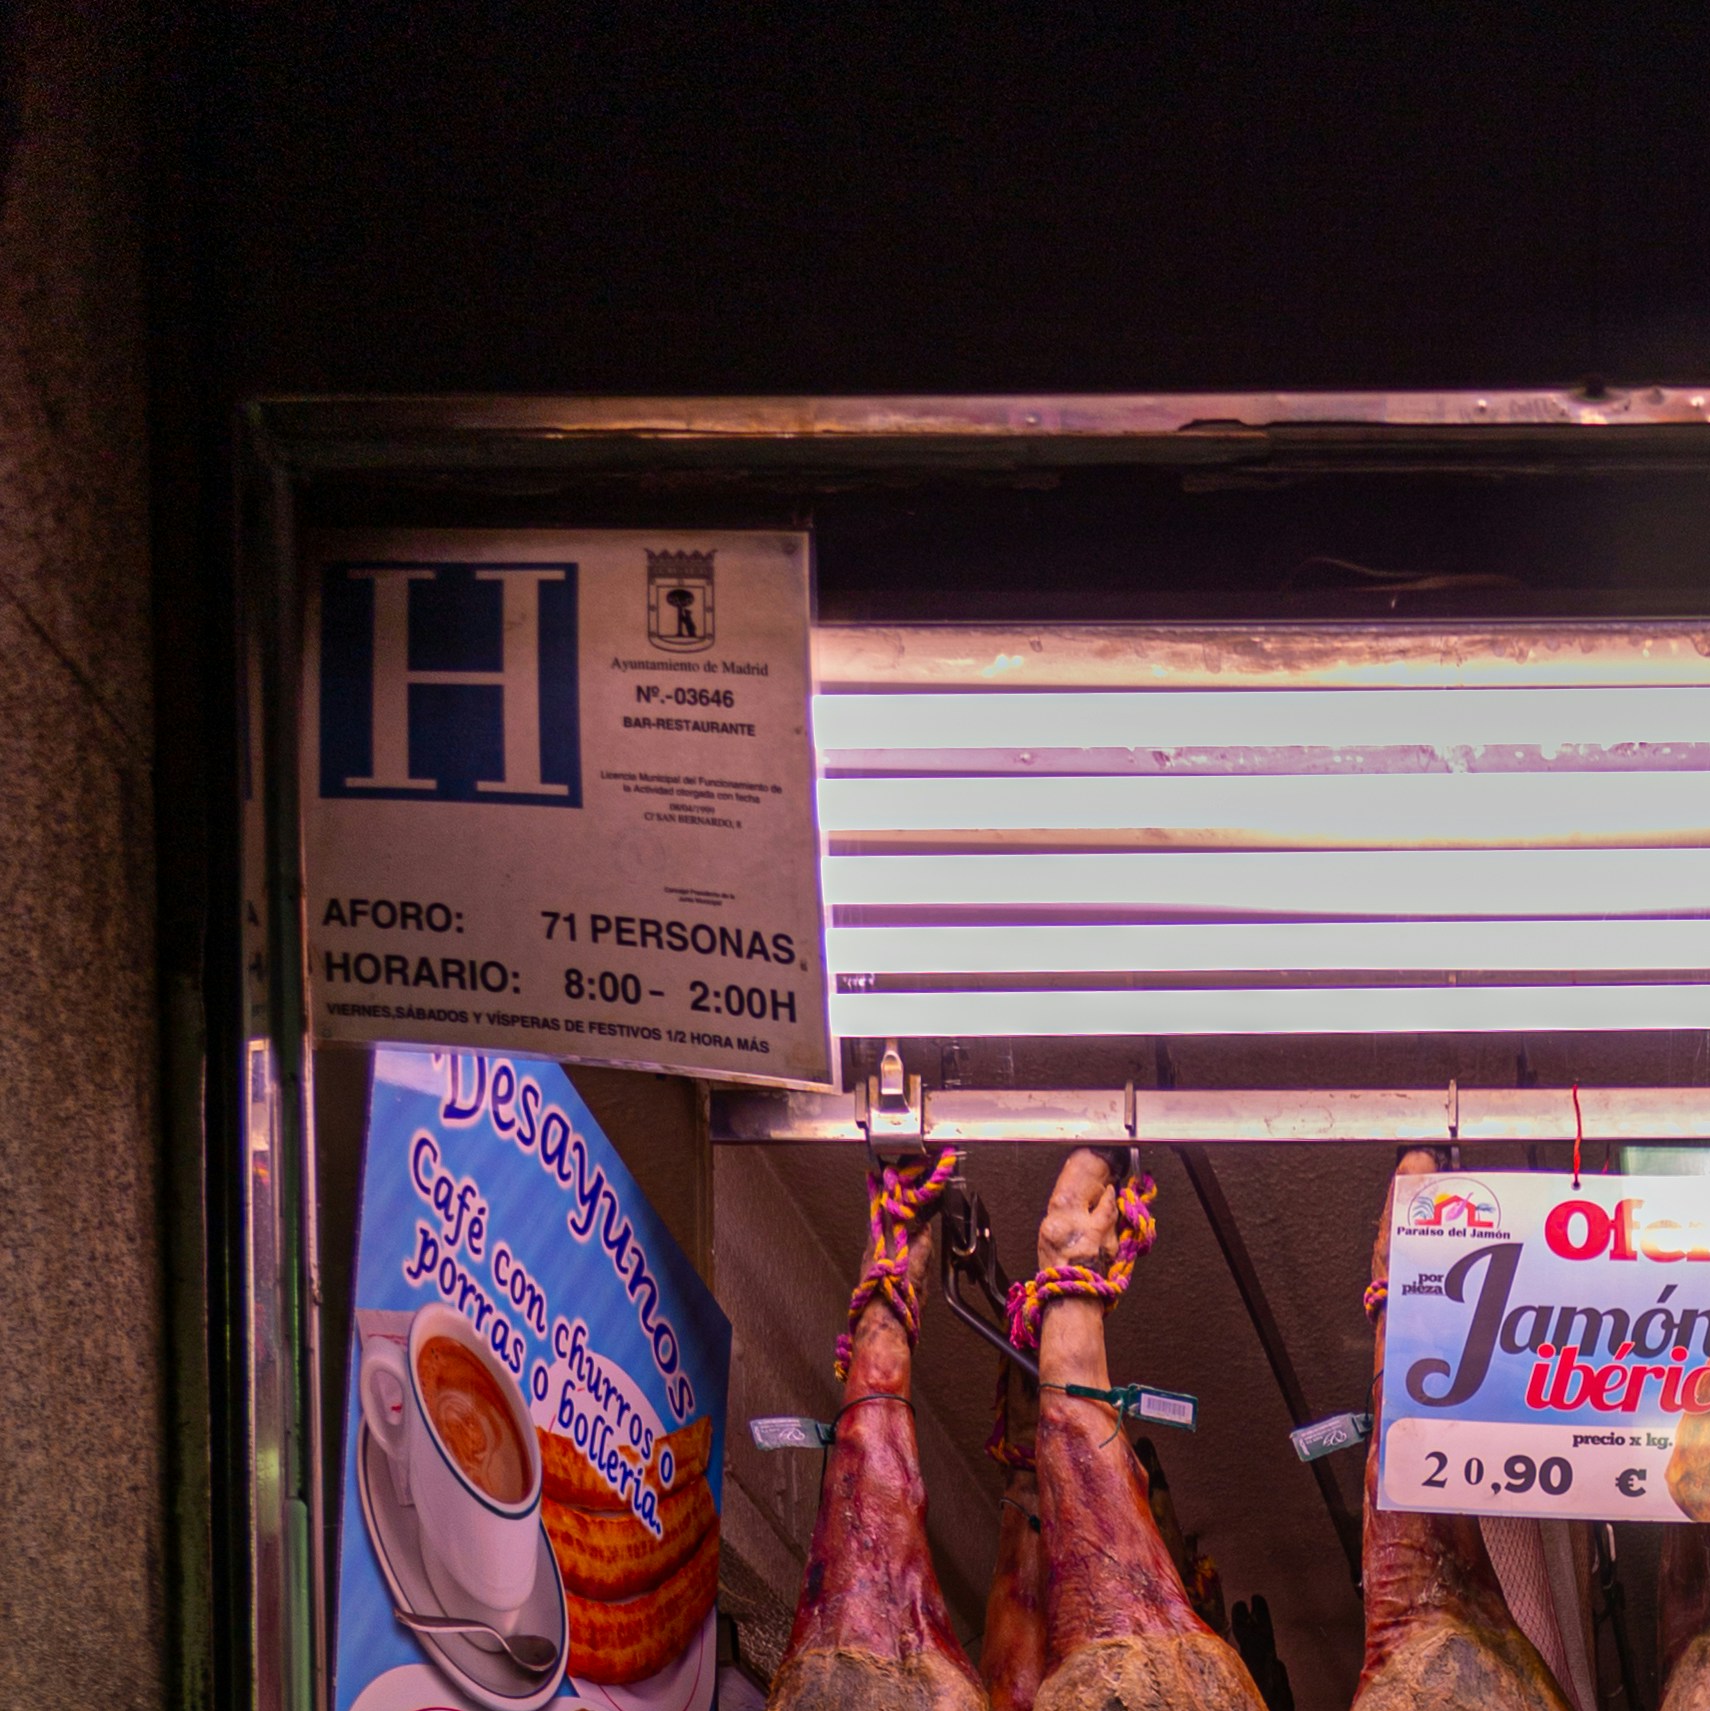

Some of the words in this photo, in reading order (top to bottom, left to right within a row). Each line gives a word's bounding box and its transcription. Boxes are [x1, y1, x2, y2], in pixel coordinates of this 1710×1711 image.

[345, 569, 569, 796] H
[611, 656, 699, 673] Ayuntamiento
[703, 660, 718, 673] de
[722, 661, 769, 678] Madrid
[623, 716, 757, 737] BAR-RESTAURANTE
[322, 898, 464, 934] AFORO:
[541, 911, 577, 942] 71
[590, 914, 797, 966] PERSONAS
[324, 952, 521, 995] HORARIO:
[564, 968, 642, 1004] 8:00
[688, 980, 798, 1023] 2:00H
[474, 1011, 484, 1024] Y
[486, 1009, 561, 1033] VÍSPERAS
[565, 1018, 586, 1034] DE
[587, 1021, 662, 1042] FESTIVOS
[666, 1028, 686, 1044] 1/2
[690, 1031, 734, 1051] HORA
[736, 1033, 771, 1054] MÁS
[434, 1056, 697, 1420] Desayunos
[1448, 1227, 1468, 1240] del
[1469, 1228, 1511, 1241] Jamón
[411, 1136, 488, 1256] Café
[493, 1247, 547, 1333] con
[552, 1320, 654, 1458] churros
[1402, 1281, 1443, 1296] pieza
[1417, 1272, 1444, 1287] por
[405, 1227, 527, 1374] porras
[1572, 1431, 1627, 1448] precio
[1629, 1435, 1642, 1448] x
[1645, 1433, 1674, 1450] kg.
[1614, 1467, 1648, 1498] €
